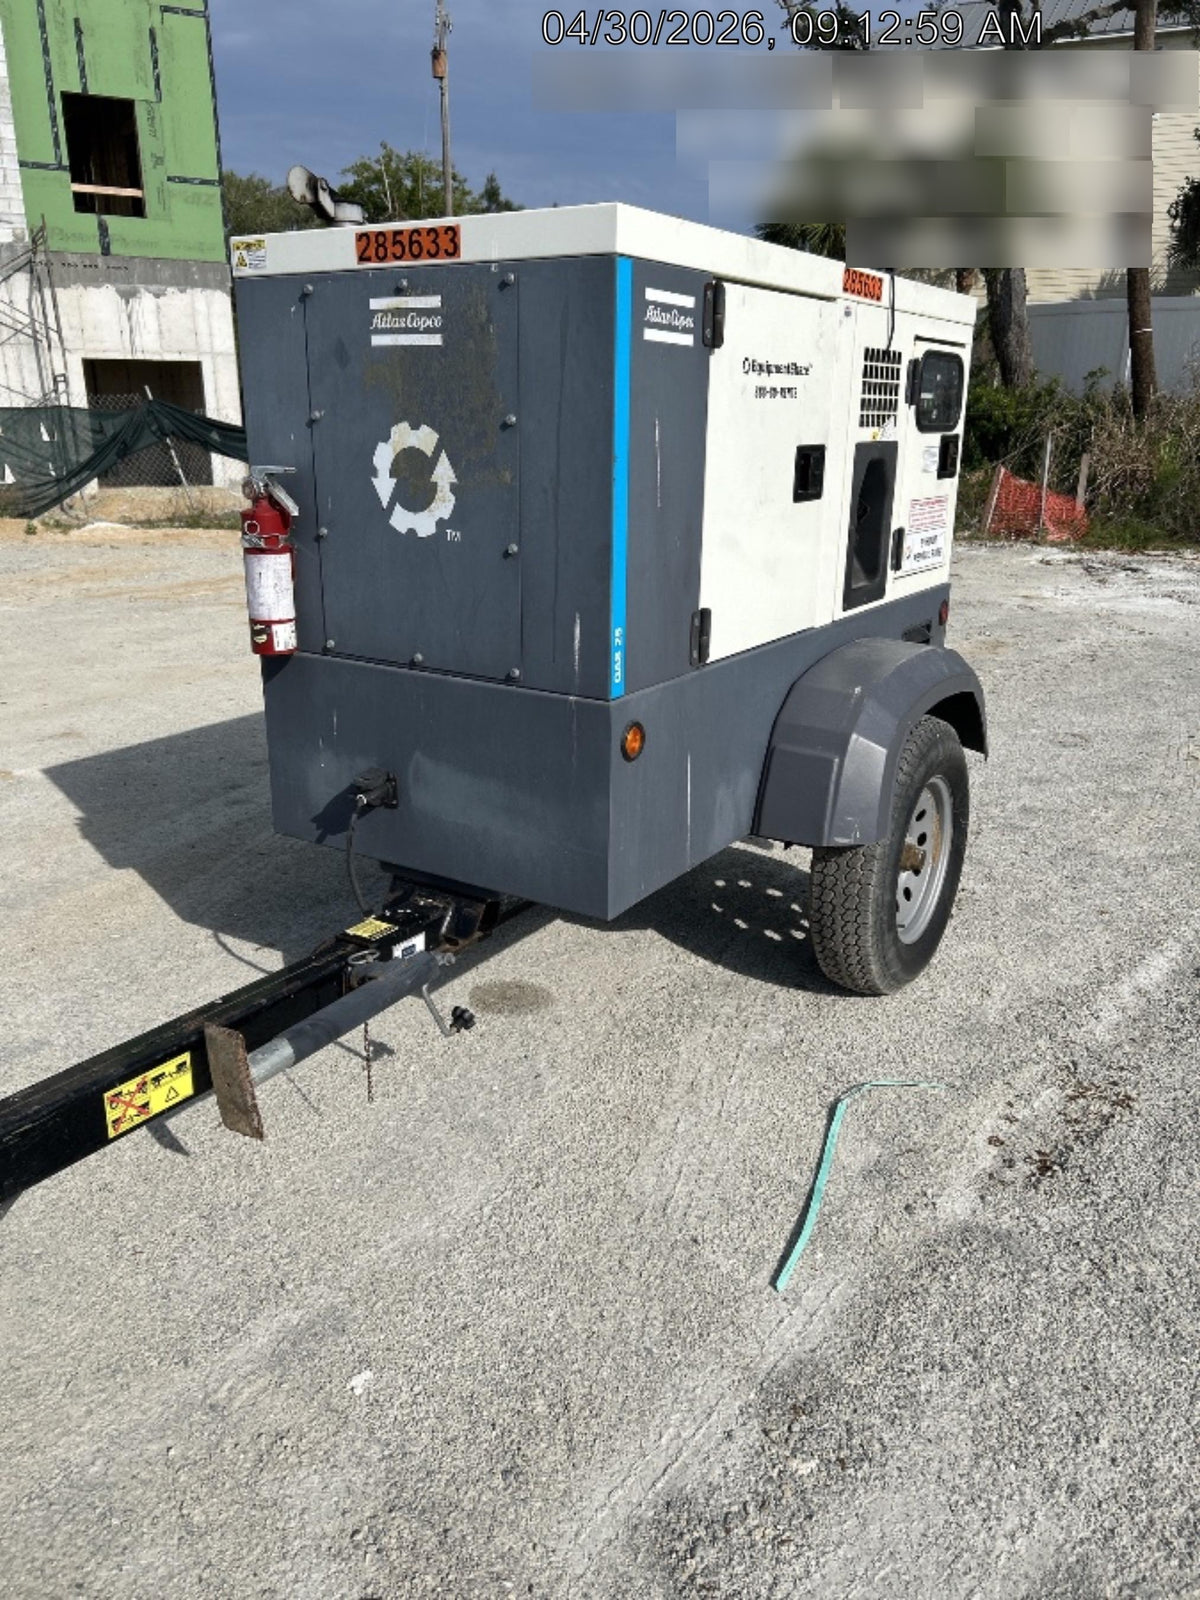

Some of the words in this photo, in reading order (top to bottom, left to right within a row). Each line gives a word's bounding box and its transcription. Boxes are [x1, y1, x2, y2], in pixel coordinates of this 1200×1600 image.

[358, 226, 459, 262] 285633
[370, 313, 406, 330] Atlas
[406, 312, 442, 331] Copco
